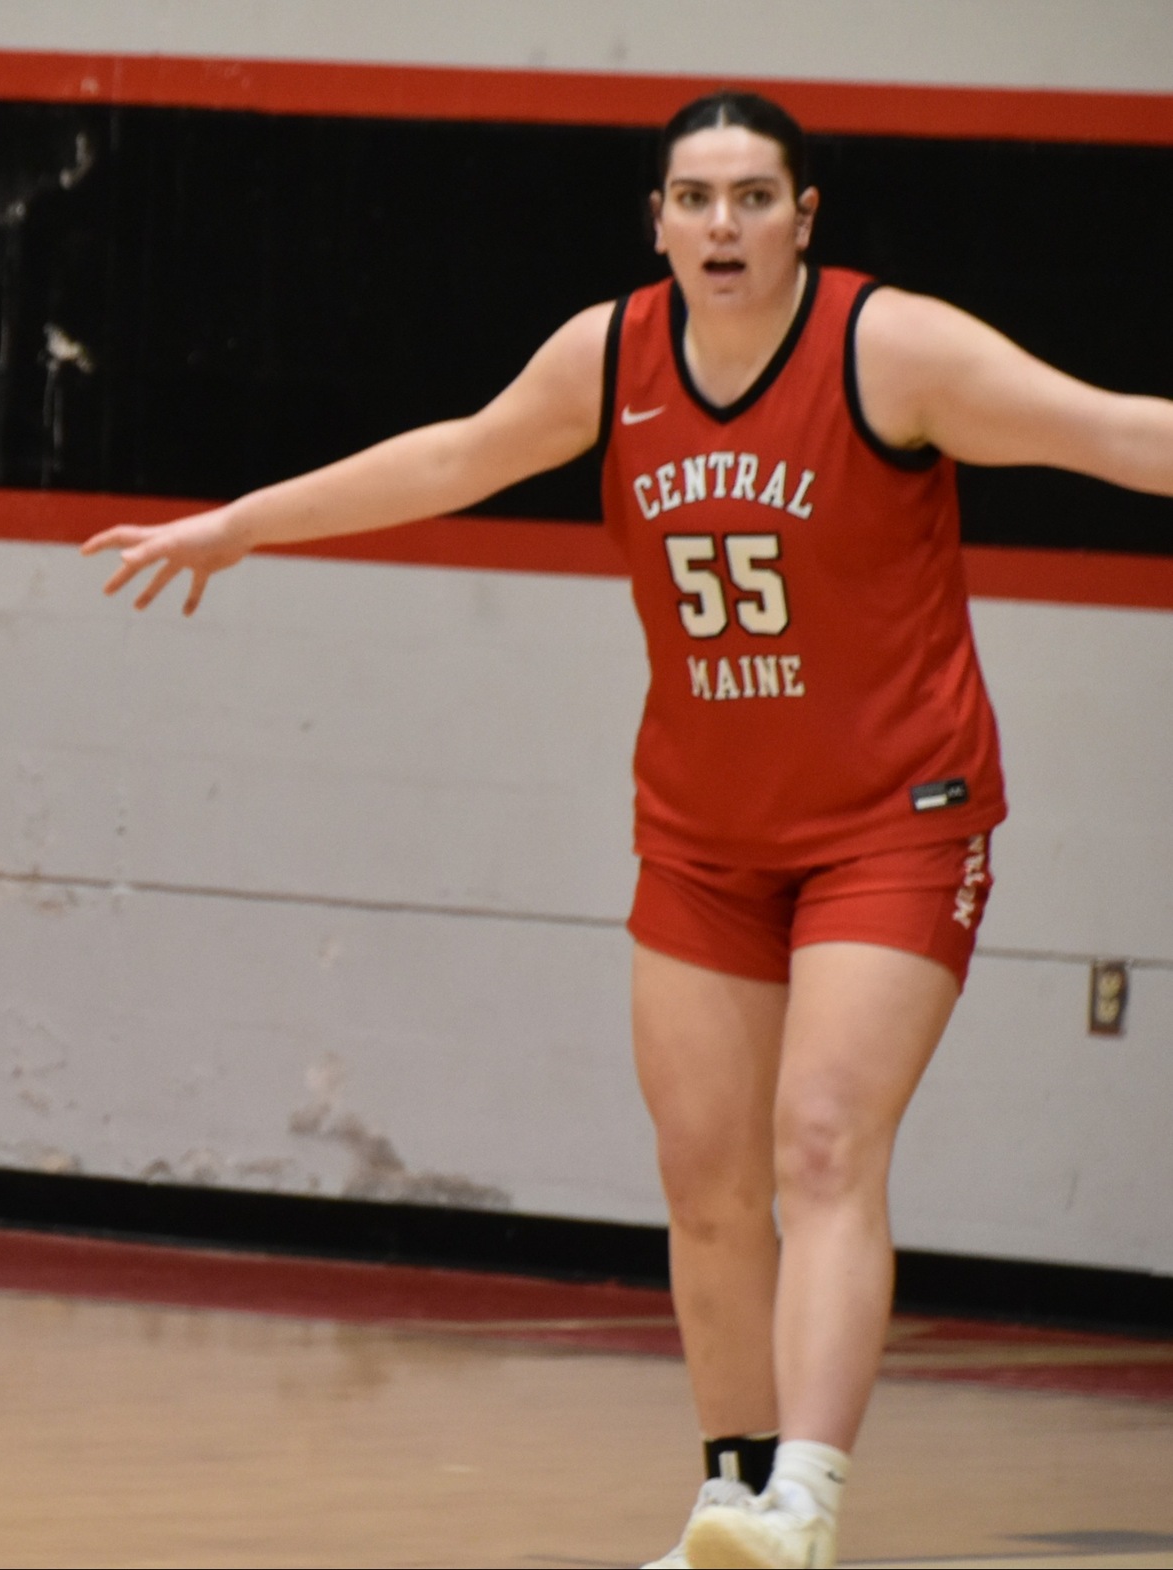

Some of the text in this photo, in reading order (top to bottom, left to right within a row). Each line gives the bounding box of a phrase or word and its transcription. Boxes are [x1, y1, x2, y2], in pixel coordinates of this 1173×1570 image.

[632, 450, 816, 521] CENTRAL
[663, 532, 789, 641] 55
[686, 653, 806, 702] MAINE
